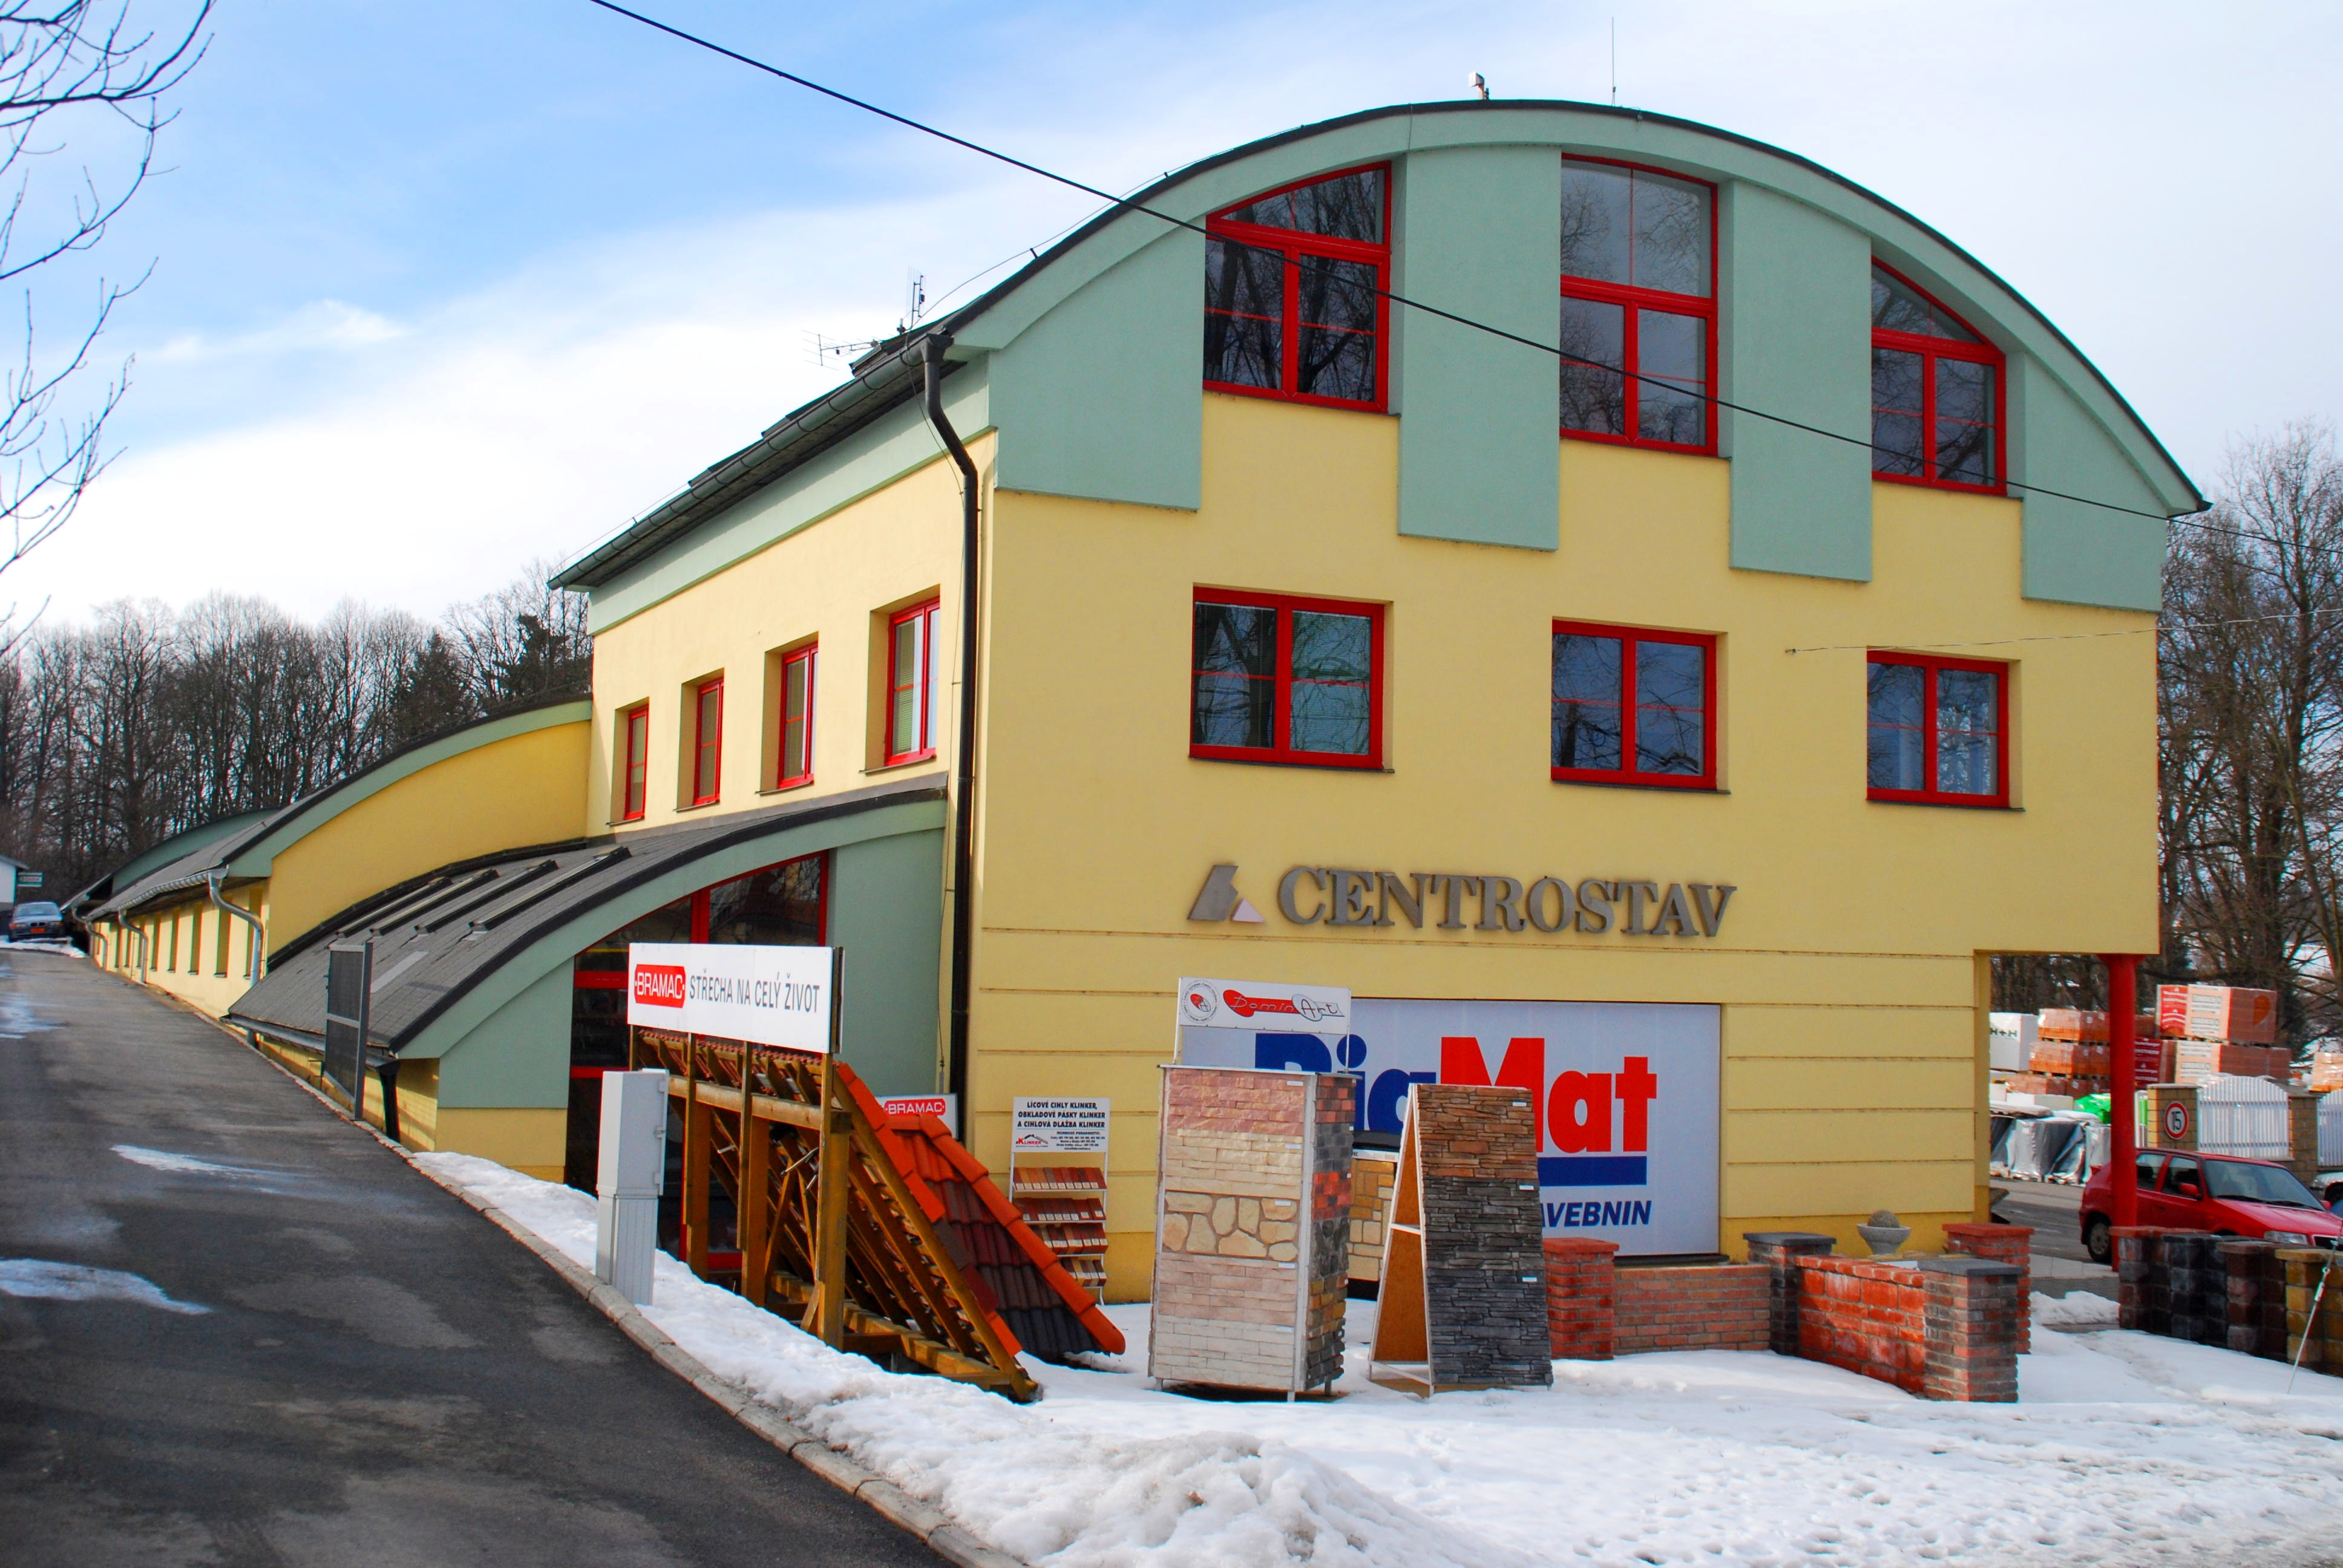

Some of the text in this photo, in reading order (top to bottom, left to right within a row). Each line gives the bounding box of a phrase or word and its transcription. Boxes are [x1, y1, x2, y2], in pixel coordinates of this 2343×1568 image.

[1276, 865, 1737, 938] CENTROSTAV
[637, 968, 820, 1013] BRAMAC STŘECHA NA CELÝ ŽIVOT
[888, 1102, 943, 1114] BRAMAC
[2171, 1111, 2182, 1130] 15
